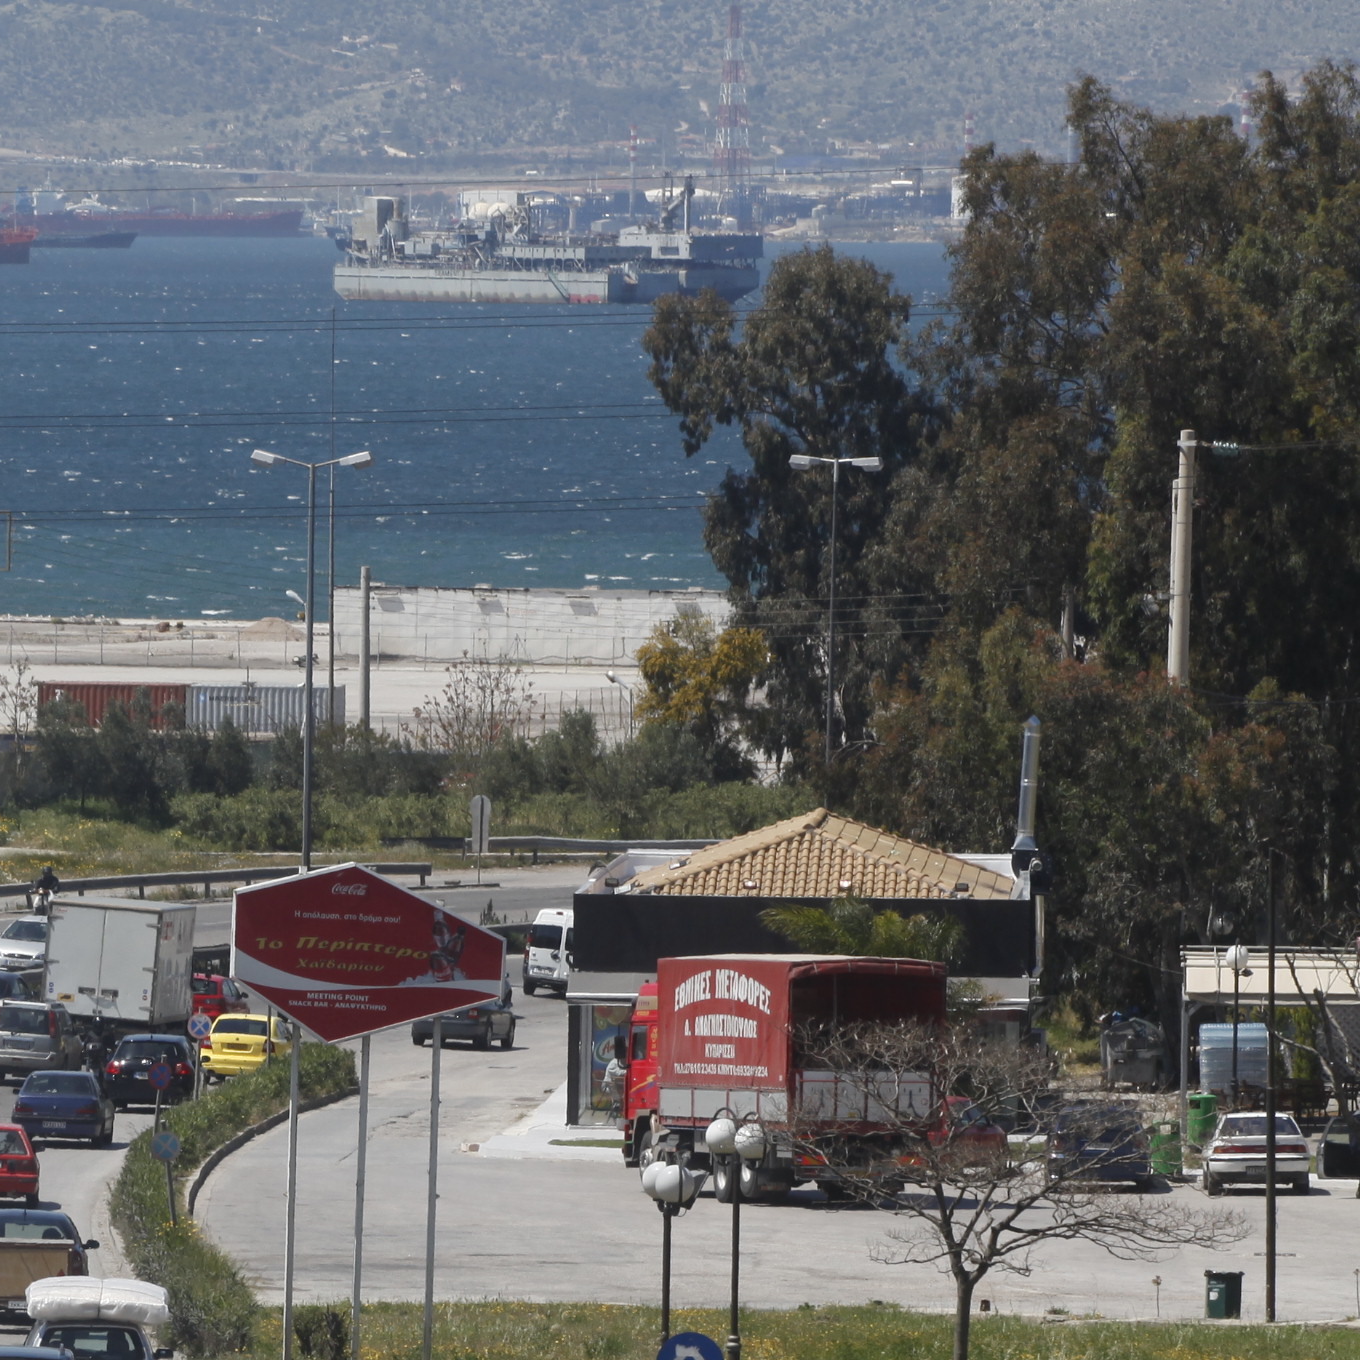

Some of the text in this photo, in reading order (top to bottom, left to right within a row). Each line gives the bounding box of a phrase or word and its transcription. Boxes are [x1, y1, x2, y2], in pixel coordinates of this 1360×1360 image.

[331, 882, 369, 896] Coca-Cola
[295, 936, 429, 960] Περίπτερο
[307, 992, 369, 1002] MEETING POINT
[674, 968, 771, 1015] ΕΘΝΙΚΕΣ ΜΕΤΑΦΟΡΕΣ
